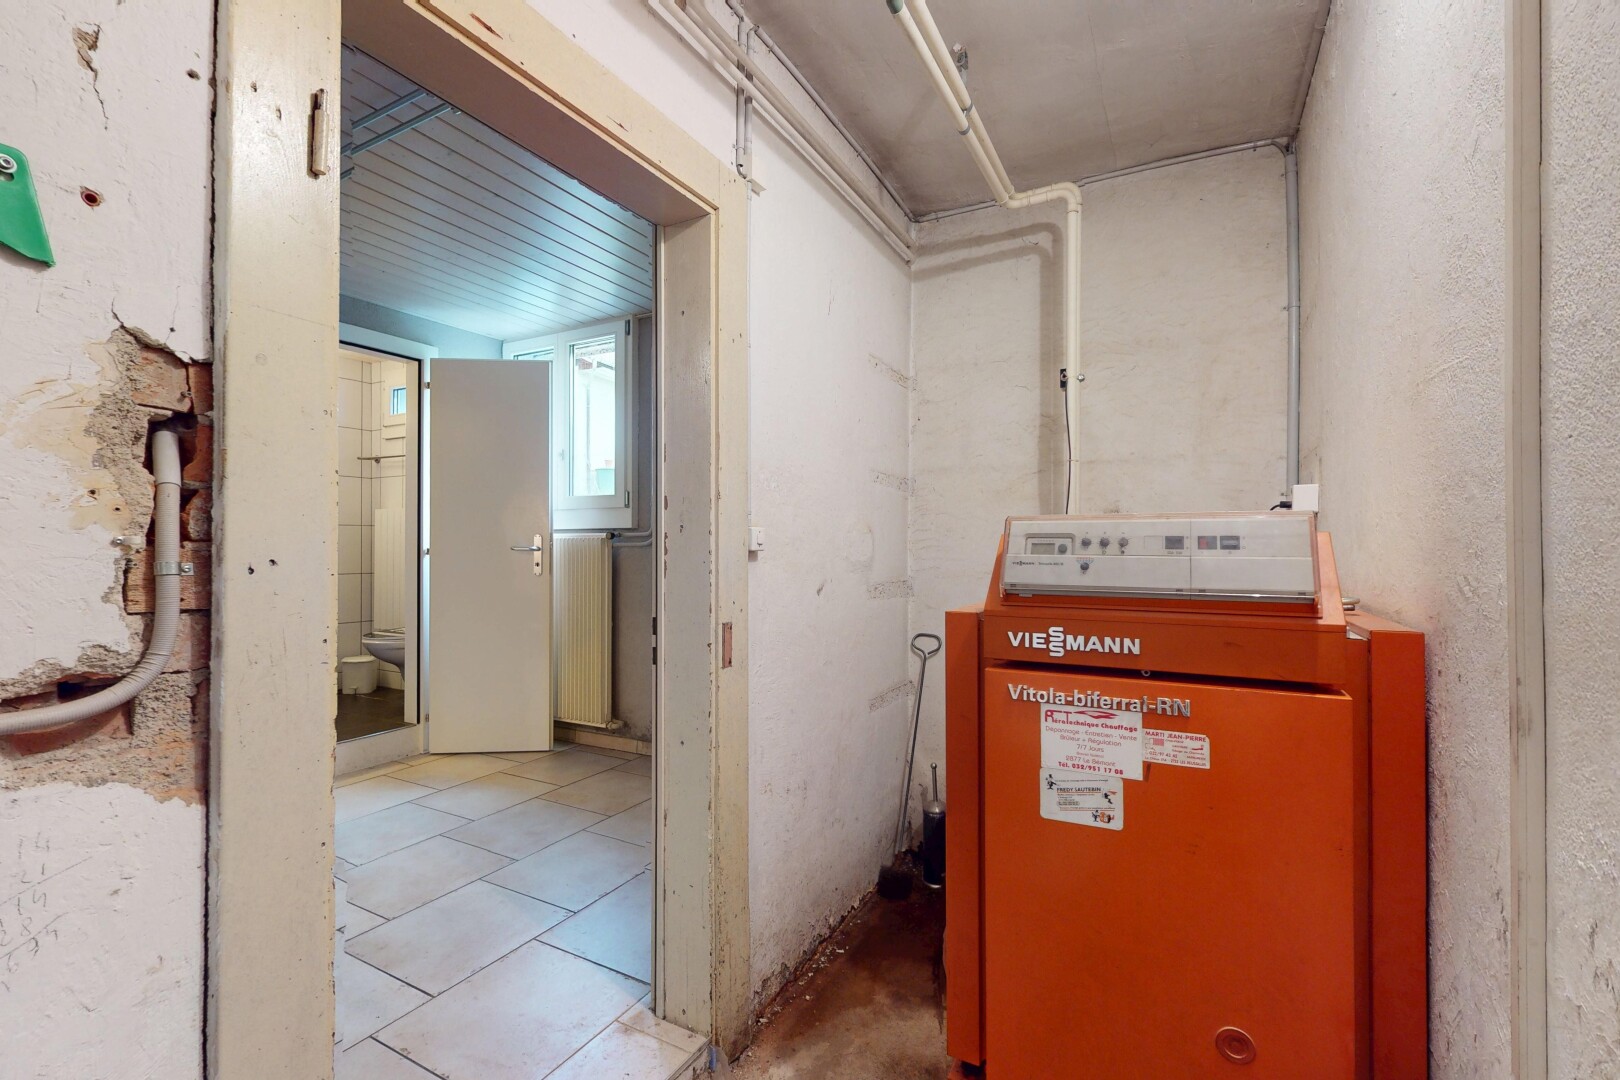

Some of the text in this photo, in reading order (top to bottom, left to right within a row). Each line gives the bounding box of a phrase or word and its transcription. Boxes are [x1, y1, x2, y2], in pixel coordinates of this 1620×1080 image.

[1007, 626, 1141, 658] VIESSMANN
[1101, 722, 1138, 732] Chauffage
[1085, 730, 1113, 739] Entretien
[1118, 734, 1138, 742] Vente
[1088, 737, 1122, 747] Régulation
[1089, 745, 1104, 753] Jours
[1066, 755, 1082, 763] 2877
[1072, 763, 1101, 772] 032/951
